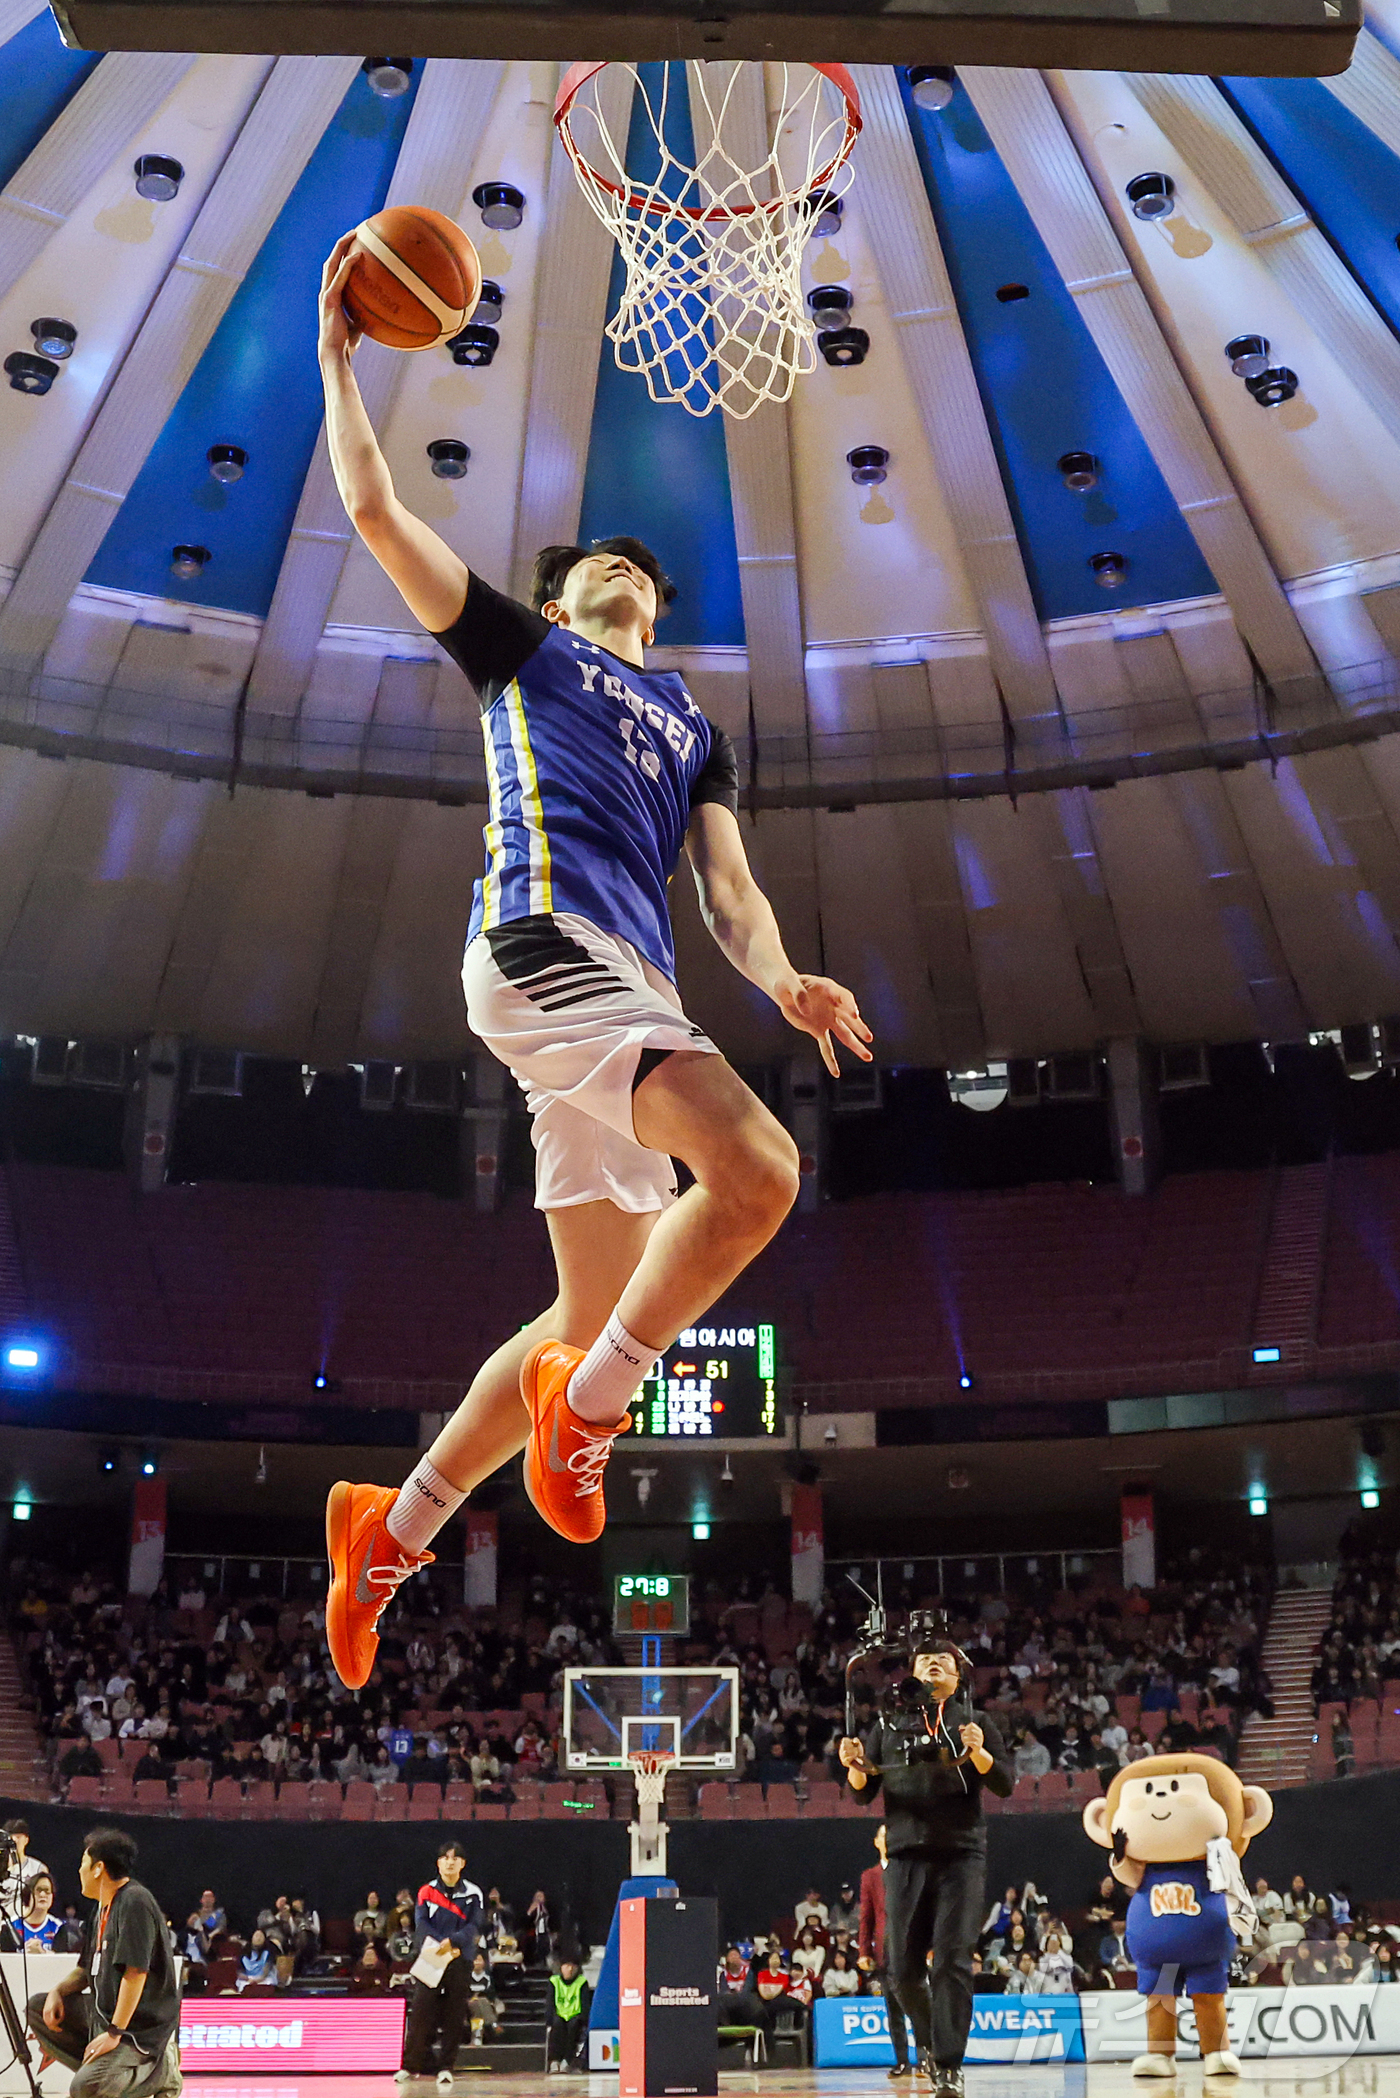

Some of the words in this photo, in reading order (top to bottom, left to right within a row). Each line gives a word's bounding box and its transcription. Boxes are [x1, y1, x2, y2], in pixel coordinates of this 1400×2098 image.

[705, 1360, 729, 1379] 51
[413, 1477, 447, 1508] sono
[650, 1994, 709, 2006] Illustrated
[660, 1986, 699, 1998] Sports
[179, 2020, 304, 2048] strated
